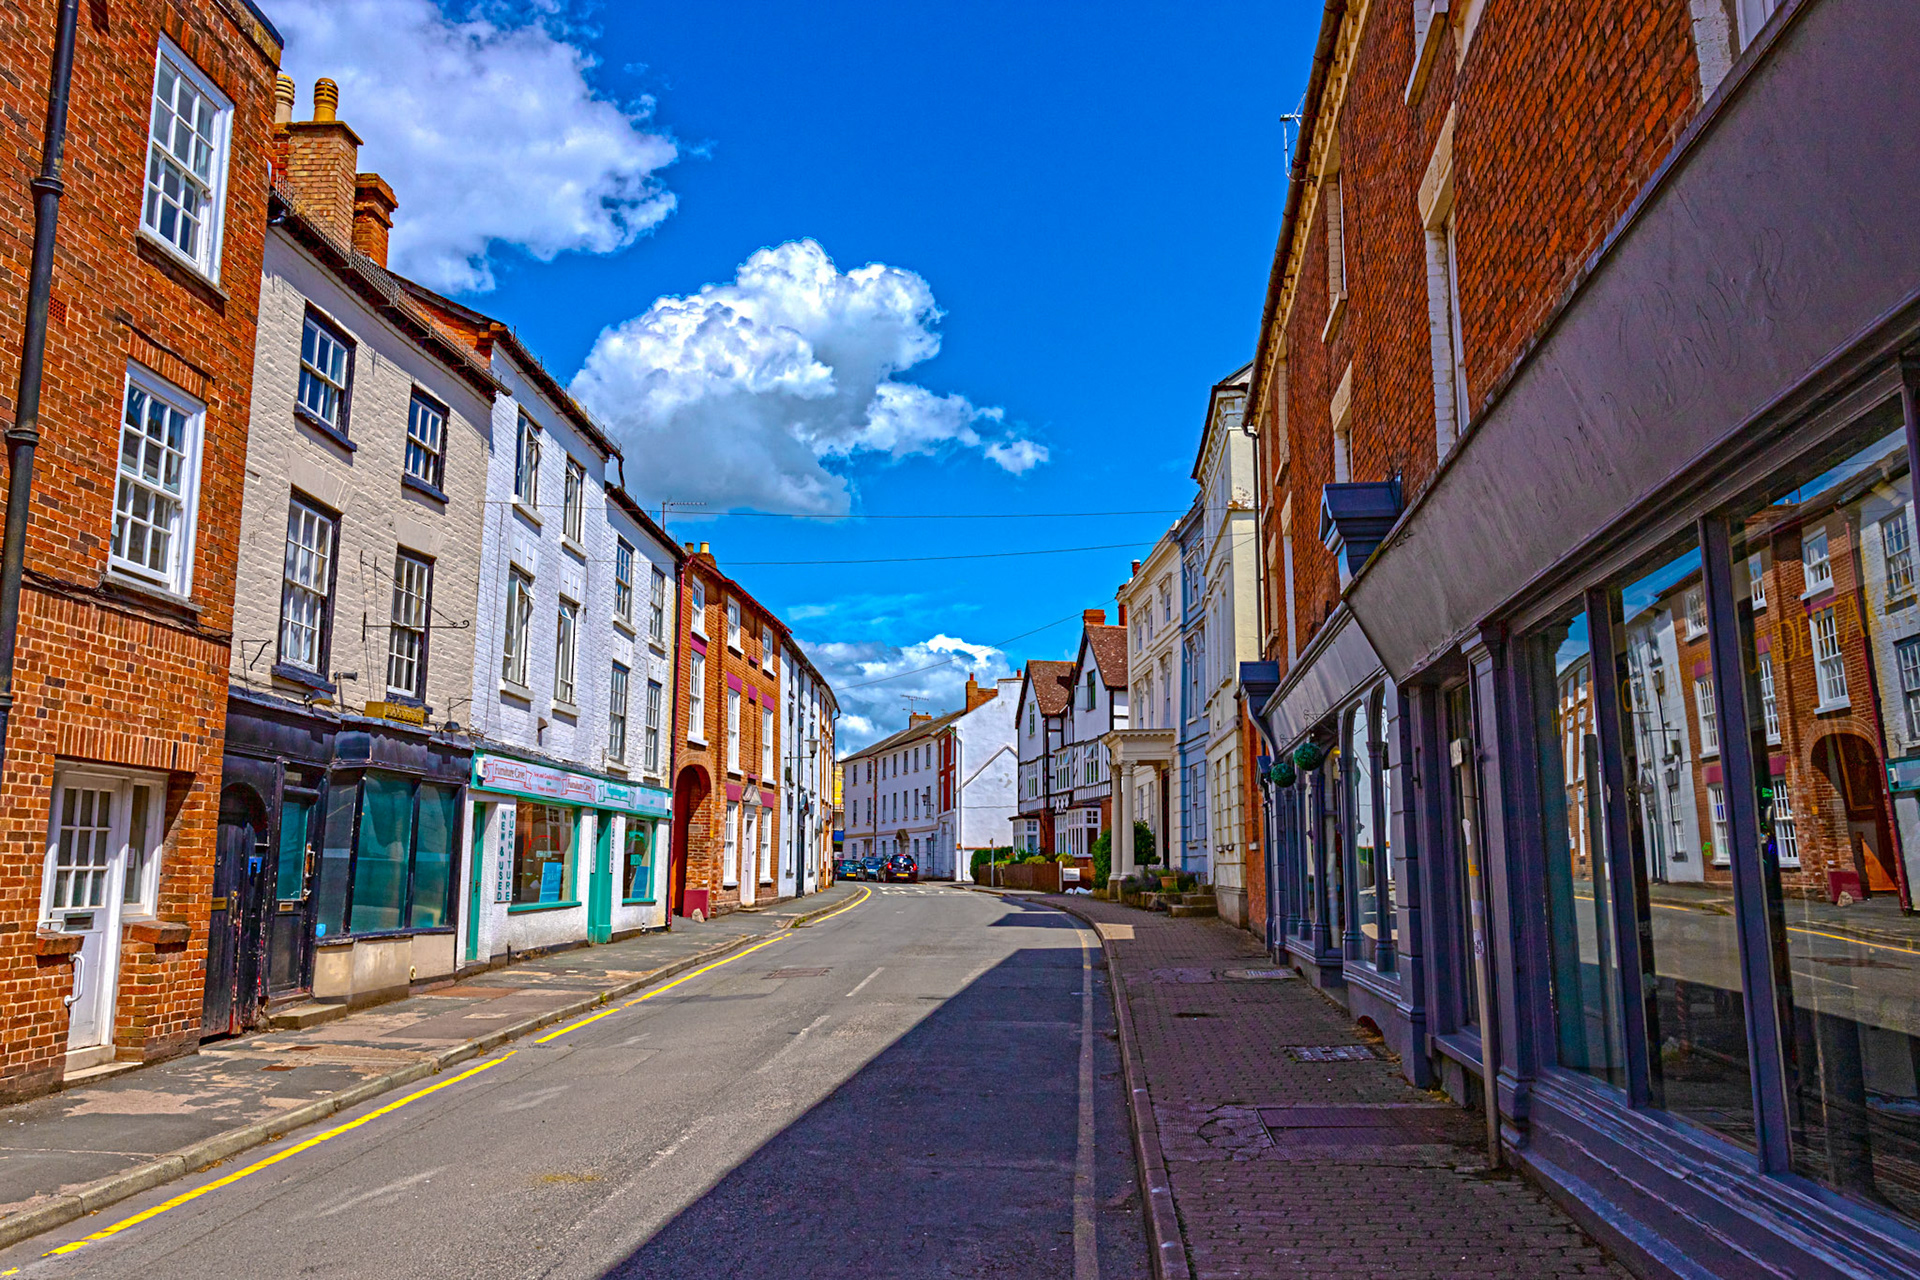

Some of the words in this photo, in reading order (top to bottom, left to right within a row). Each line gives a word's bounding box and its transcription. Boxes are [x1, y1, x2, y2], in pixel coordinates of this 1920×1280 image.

[494, 763, 514, 778] Furniture
[499, 846, 504, 857] &
[505, 810, 515, 901] FURNITURE
[496, 861, 504, 901] USED
